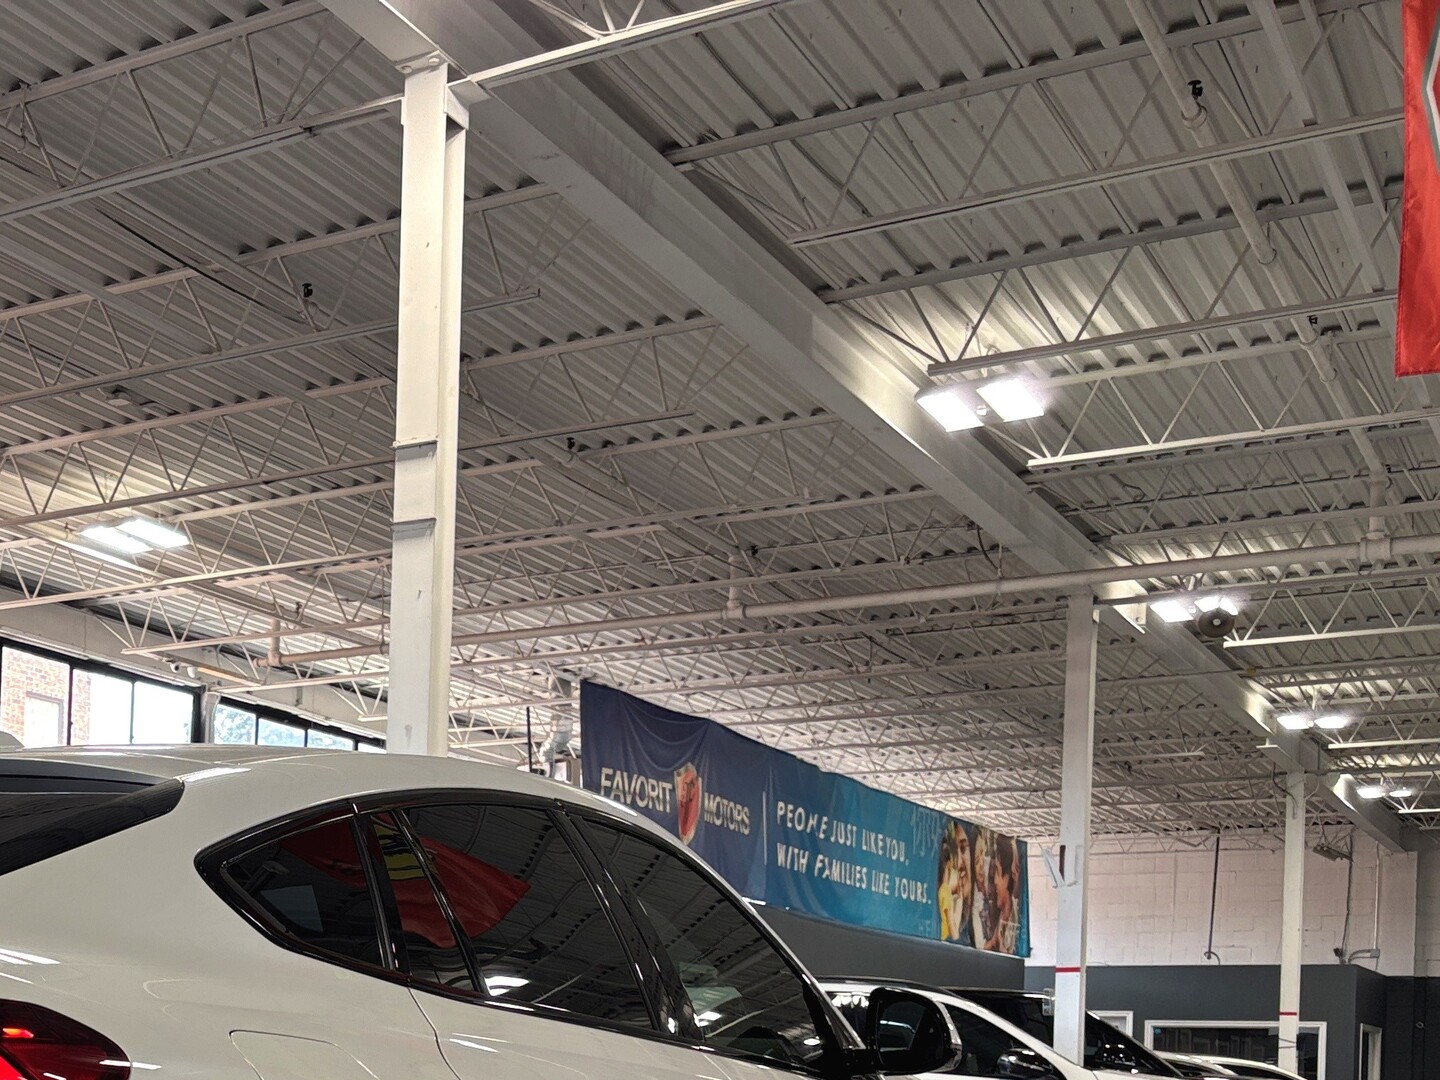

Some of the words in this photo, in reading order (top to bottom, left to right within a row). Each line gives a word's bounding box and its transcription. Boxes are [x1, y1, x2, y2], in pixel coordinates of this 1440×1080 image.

[601, 767, 672, 814] FAVORIT
[704, 792, 750, 835] MOTORS
[777, 842, 809, 874] WITH
[814, 854, 867, 890] FAMILIES
[871, 870, 890, 895] LIKE
[895, 876, 931, 904] YOURS.
[830, 820, 857, 848] JUST
[862, 829, 884, 855] LIKE
[886, 837, 909, 866] YOU.
